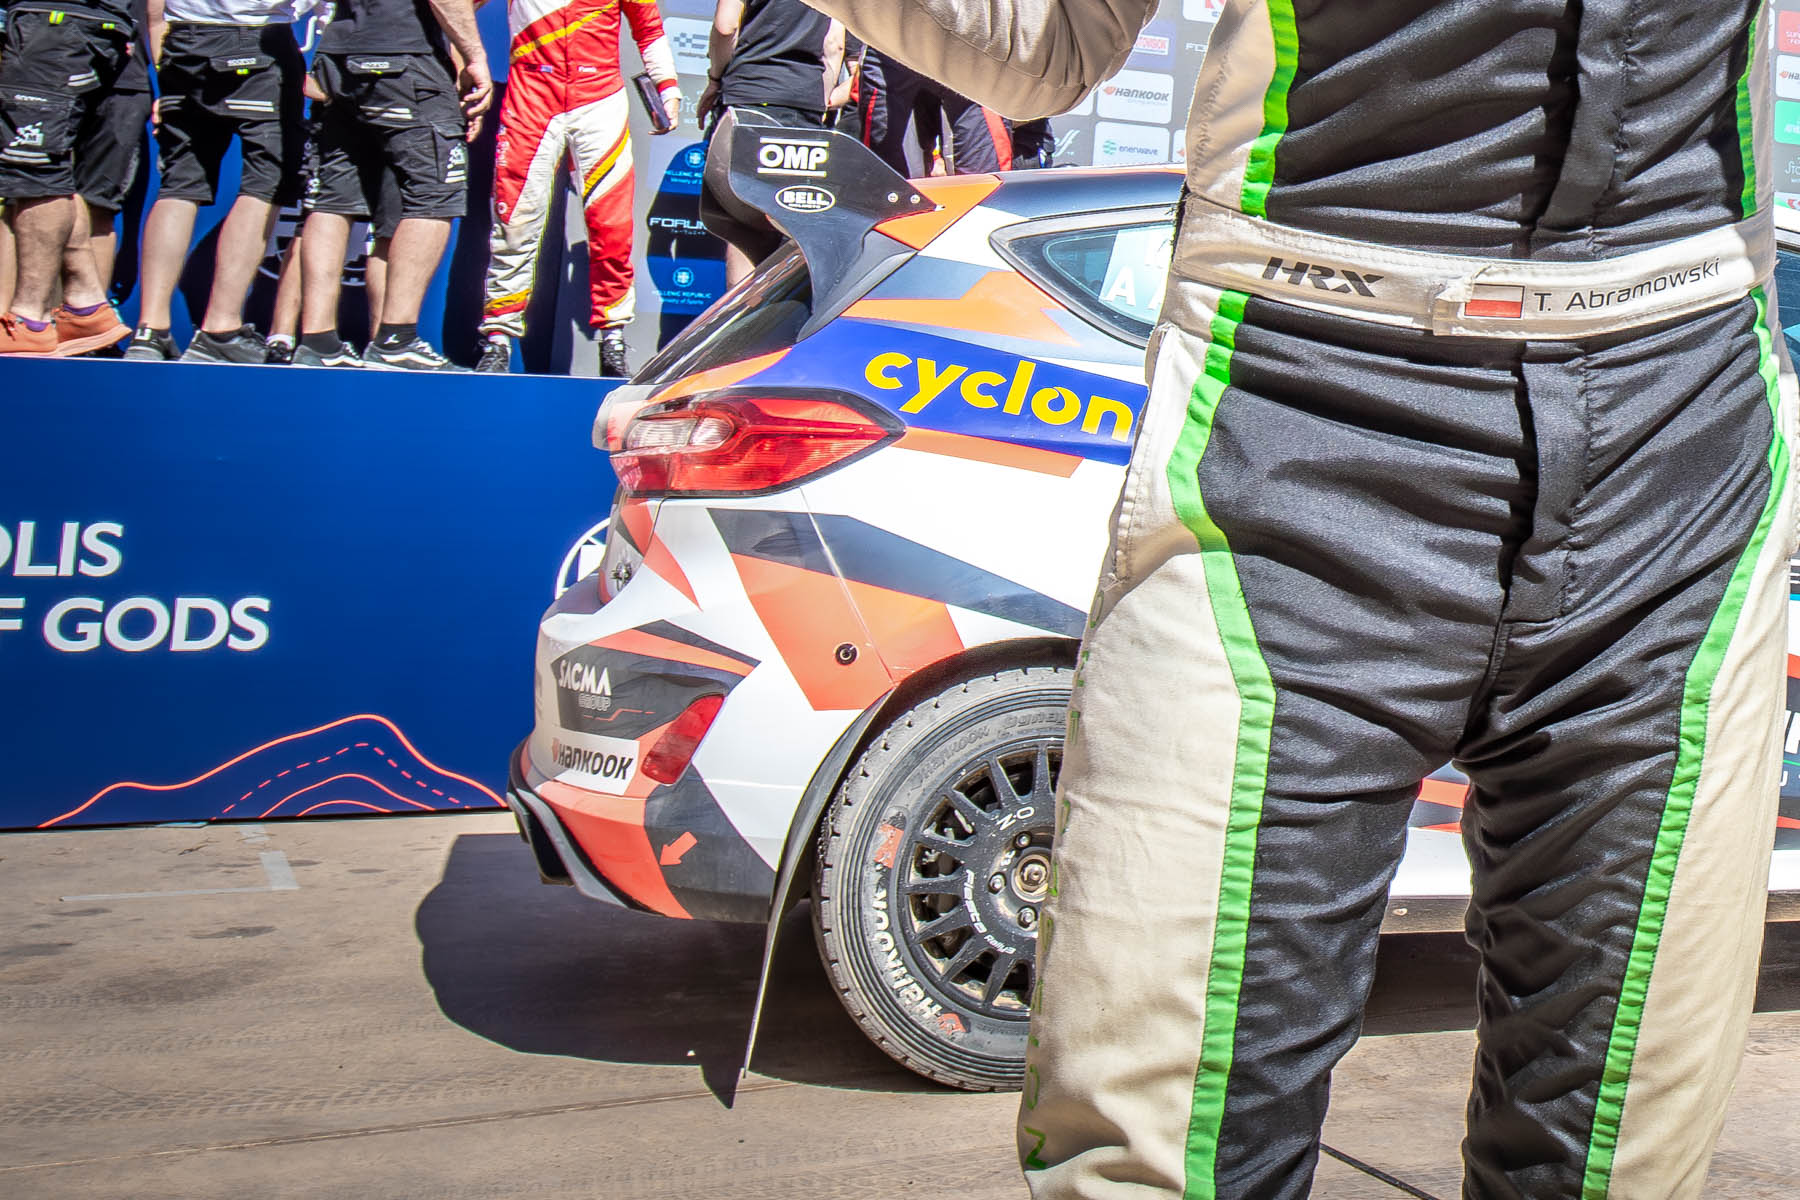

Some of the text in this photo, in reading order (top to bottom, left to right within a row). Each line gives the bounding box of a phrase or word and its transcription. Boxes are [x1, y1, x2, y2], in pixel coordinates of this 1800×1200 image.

[759, 143, 828, 171] OMP
[783, 191, 830, 206] BELL
[1261, 256, 1385, 298] HRX
[1534, 256, 1722, 313] T. Abramowski
[864, 351, 1135, 443] cyclon
[43, 596, 271, 653] GODS
